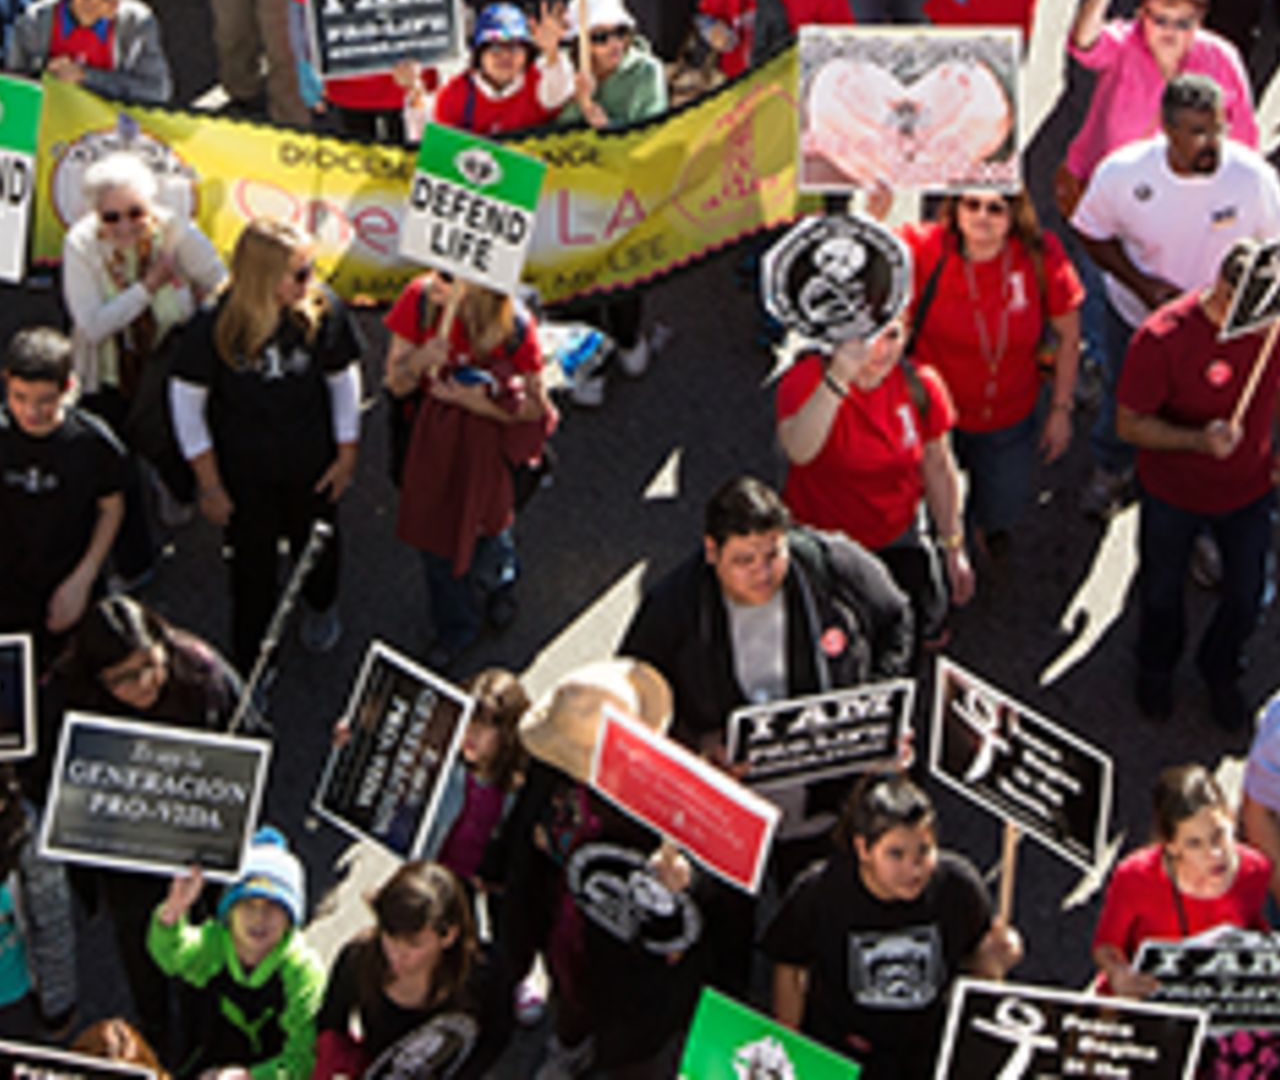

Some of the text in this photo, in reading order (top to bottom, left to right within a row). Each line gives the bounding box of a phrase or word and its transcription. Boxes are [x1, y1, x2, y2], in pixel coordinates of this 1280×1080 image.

[410, 176, 527, 246] DEFEND
[557, 188, 648, 246] LA
[429, 222, 490, 273] LIFE
[1007, 271, 1028, 309] 1
[747, 691, 895, 741] I AM
[88, 792, 223, 830] PRO-VIDA
[1155, 951, 1182, 976] I
[1062, 1013, 1135, 1037] Peace
[1077, 1037, 1158, 1063] Begins
